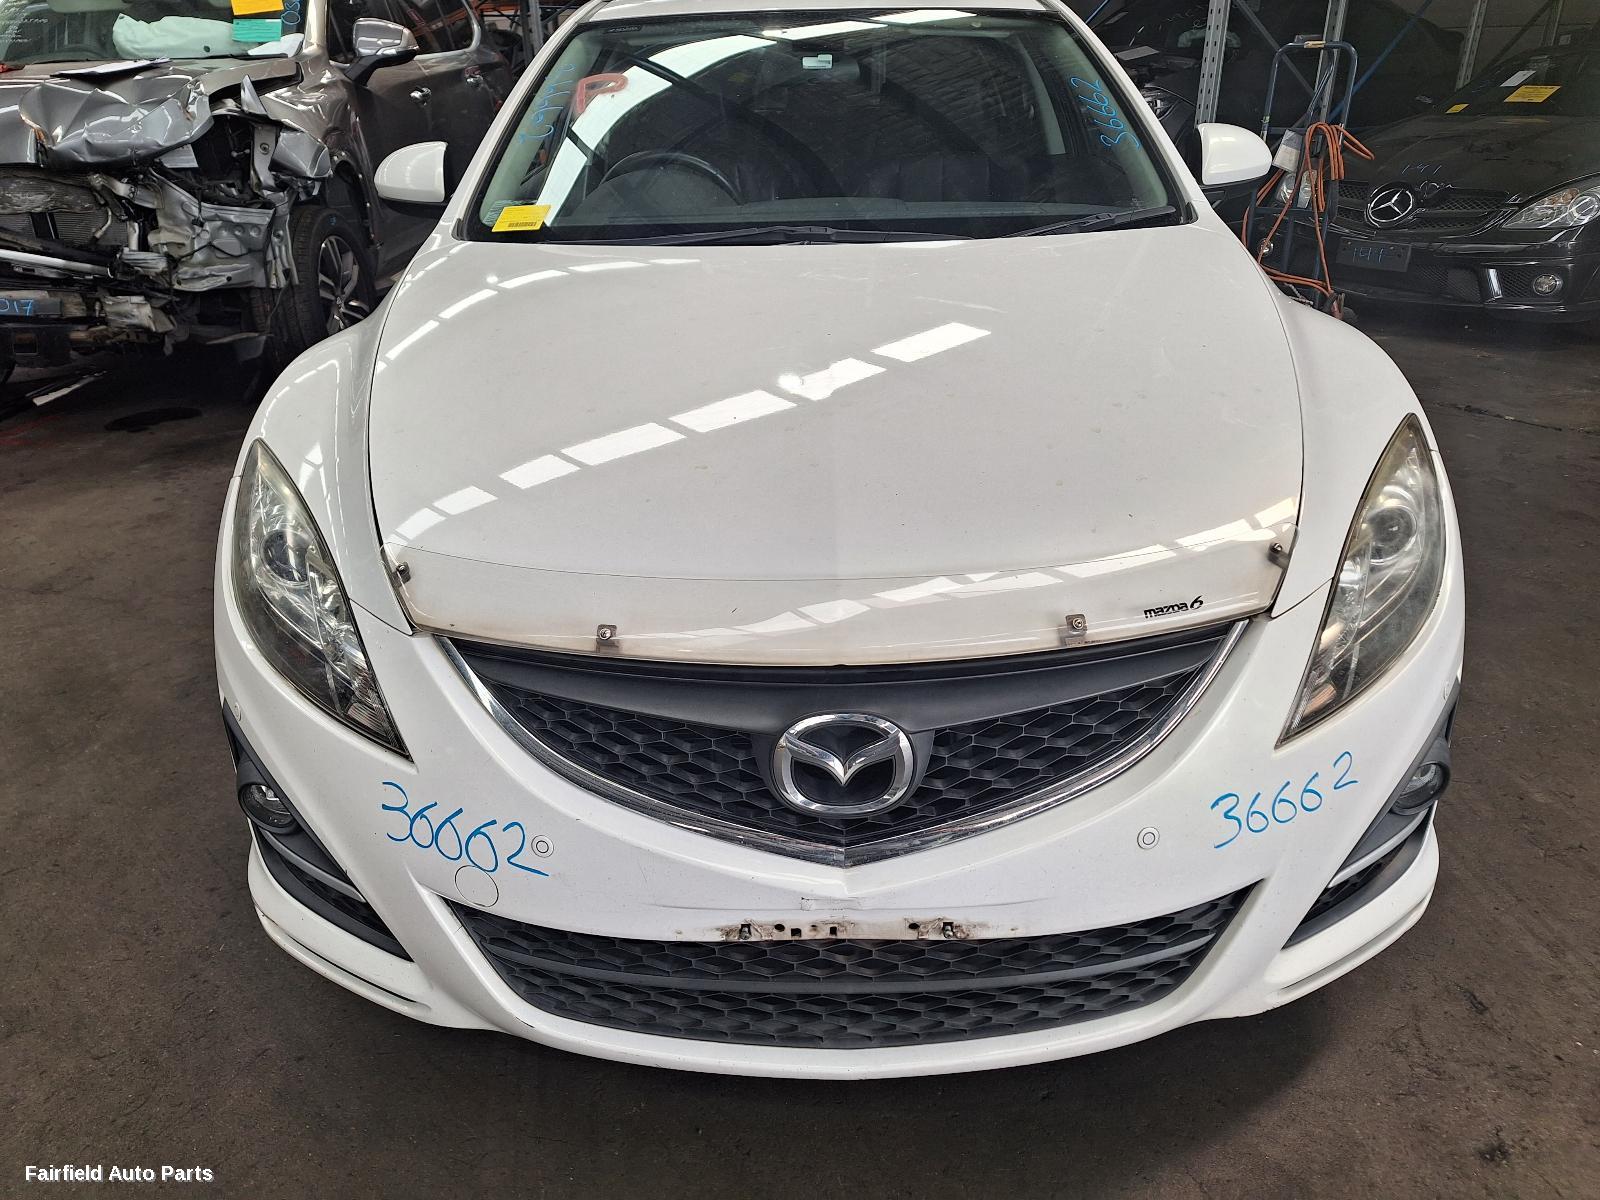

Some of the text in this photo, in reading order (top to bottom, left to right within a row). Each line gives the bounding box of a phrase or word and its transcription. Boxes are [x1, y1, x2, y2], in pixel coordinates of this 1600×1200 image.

[1070, 77, 1140, 151] 36662
[382, 781, 550, 877] 36662
[1210, 750, 1359, 849] 36662
